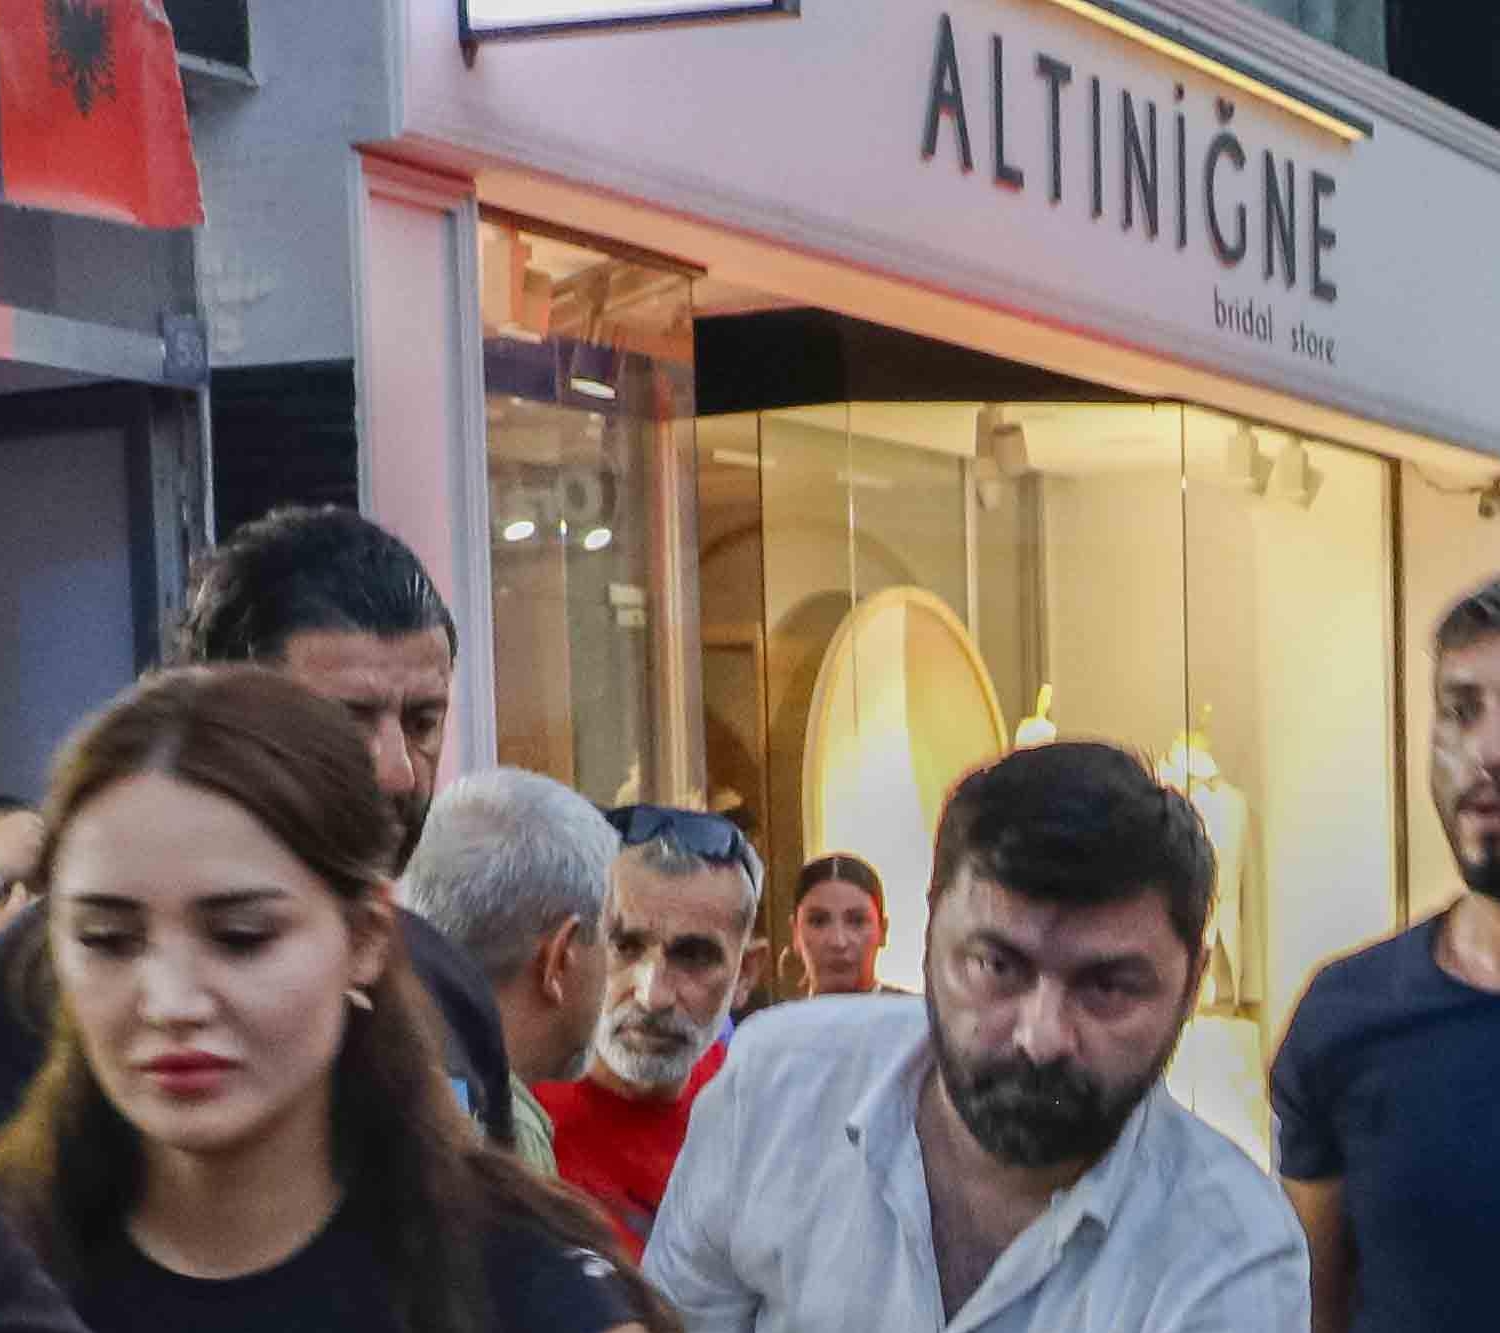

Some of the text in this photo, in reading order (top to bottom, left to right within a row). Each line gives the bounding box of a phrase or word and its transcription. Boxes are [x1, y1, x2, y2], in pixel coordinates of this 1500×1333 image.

[919, 11, 1337, 302] ALTINİĞNE
[1213, 286, 1336, 366] bridal store
